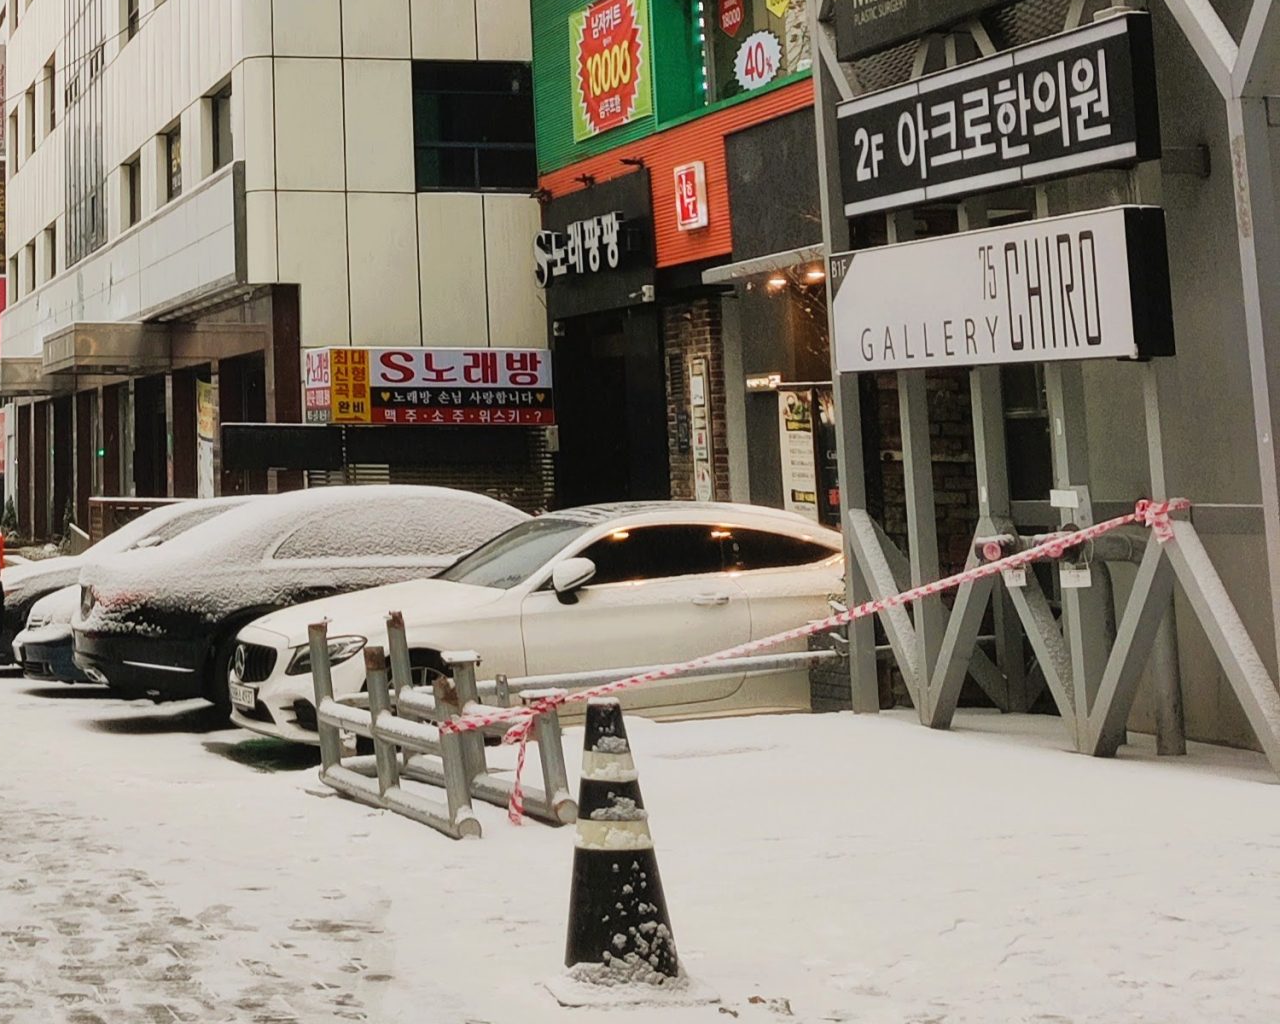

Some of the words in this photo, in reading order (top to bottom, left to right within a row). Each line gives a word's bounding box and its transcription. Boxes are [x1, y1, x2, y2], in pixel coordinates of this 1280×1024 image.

[590, 3, 622, 39] 남자커트
[586, 40, 631, 98] 10000
[854, 127, 887, 182] 2F
[897, 48, 1112, 180] 아크로한의원
[830, 258, 848, 280] B1F
[1004, 229, 1103, 352] CHIRO
[860, 315, 1000, 363] GALLERY
[379, 351, 542, 386] S노래방
[393, 390, 432, 405] 노래방
[438, 390, 462, 405] 손님
[469, 390, 534, 405] 사랑합니다
